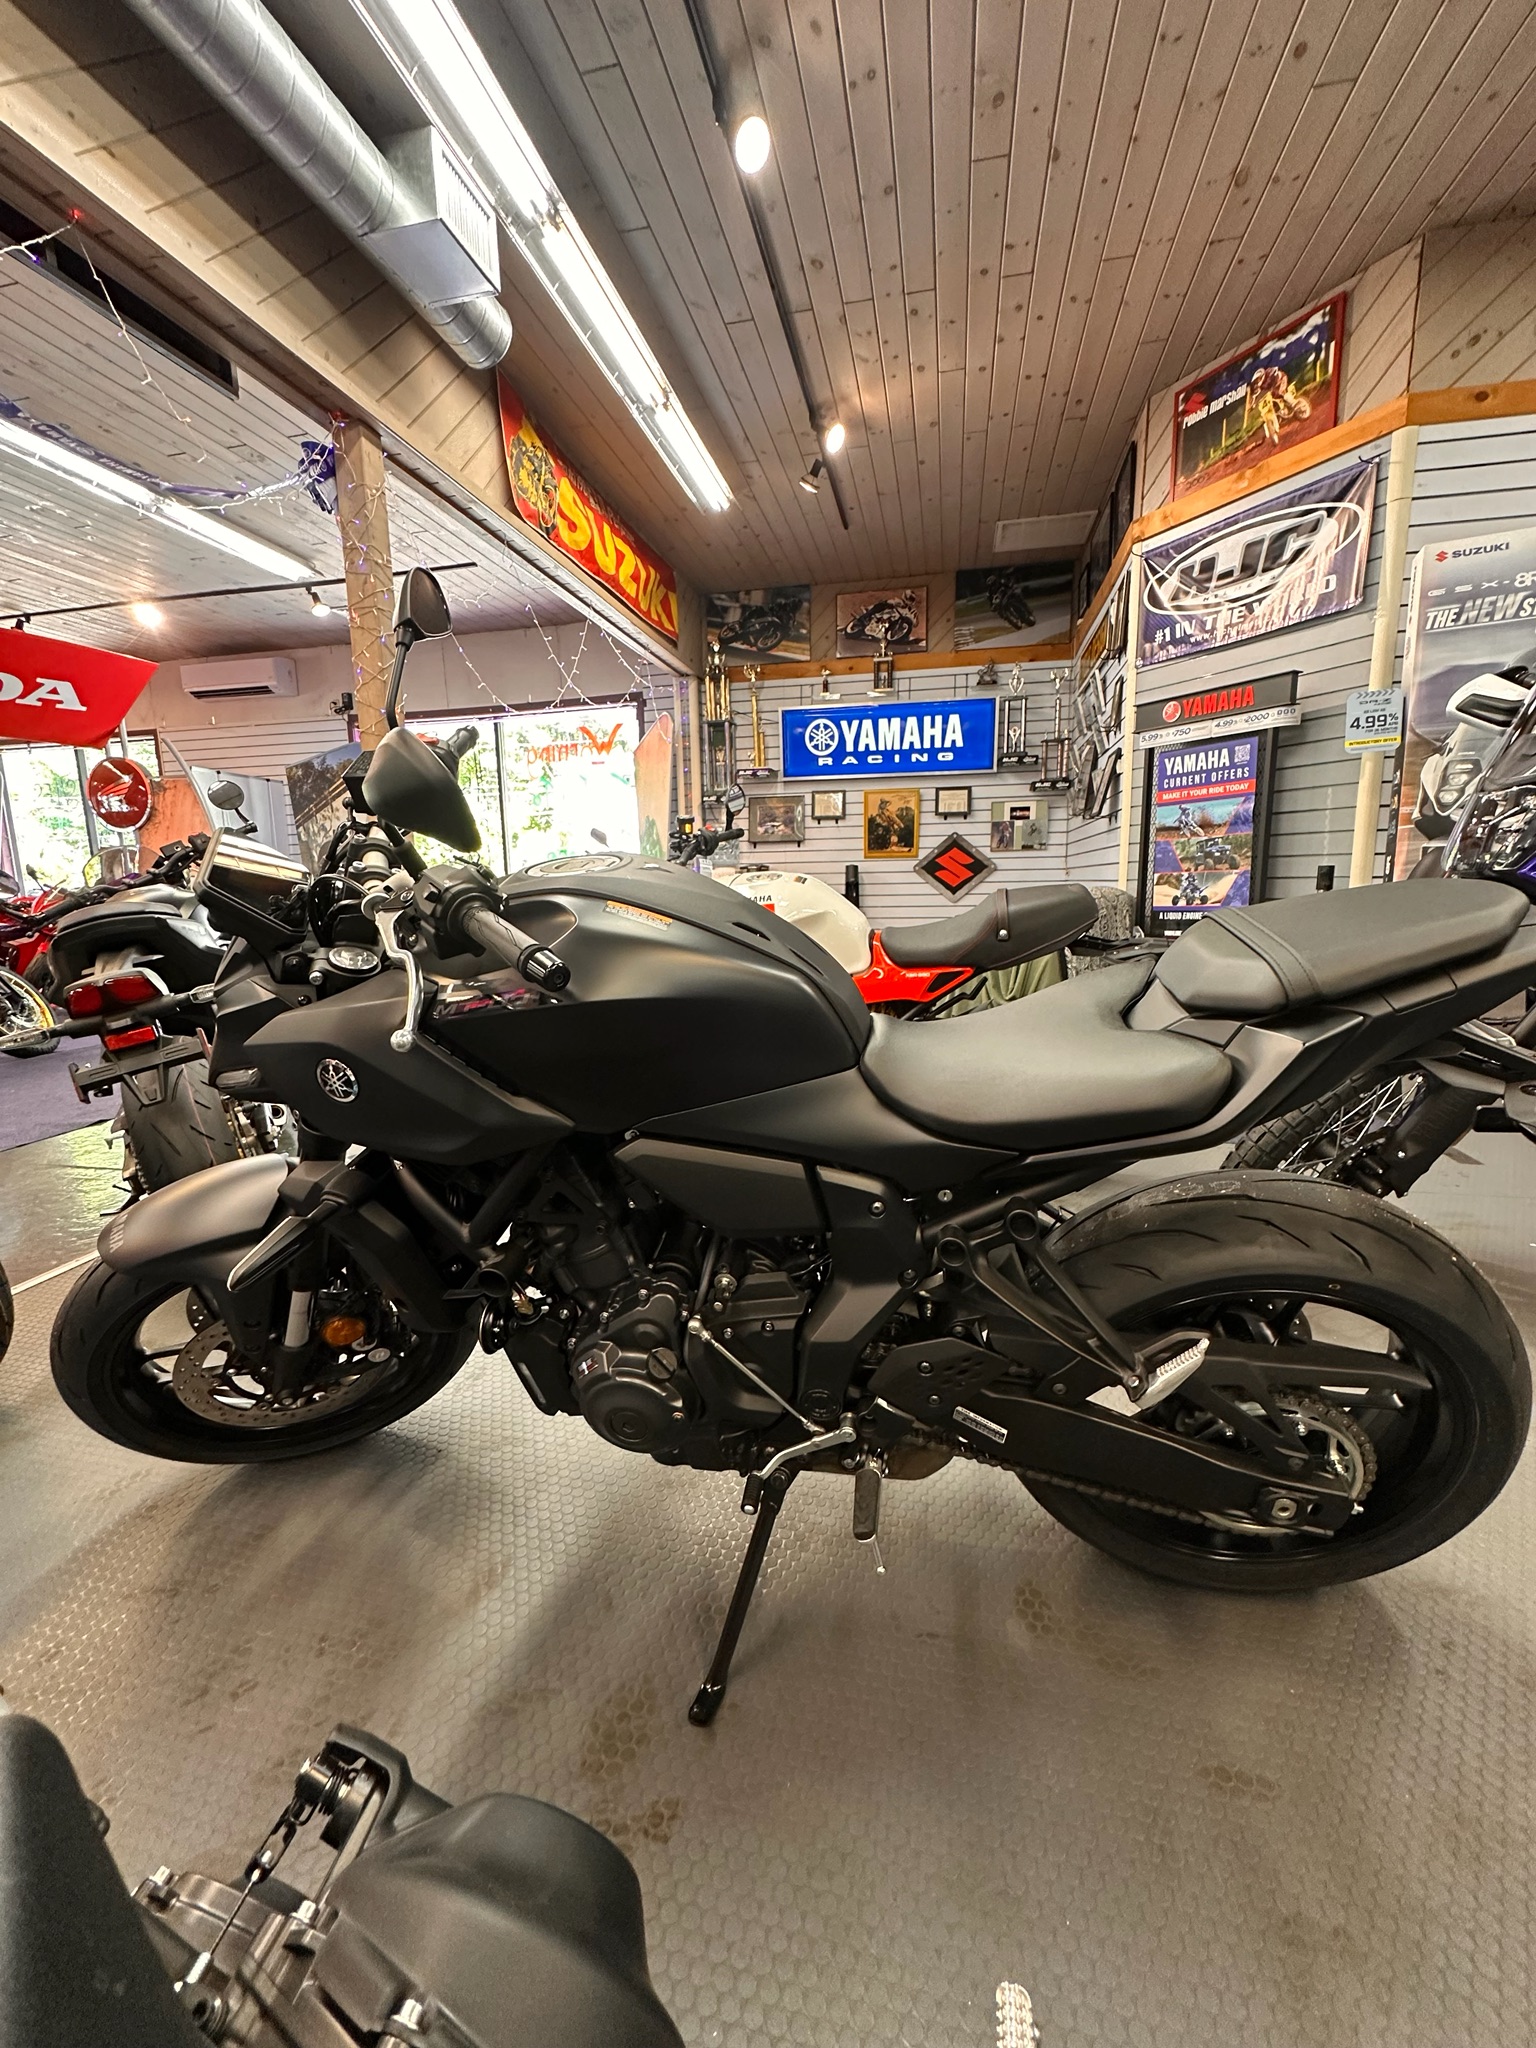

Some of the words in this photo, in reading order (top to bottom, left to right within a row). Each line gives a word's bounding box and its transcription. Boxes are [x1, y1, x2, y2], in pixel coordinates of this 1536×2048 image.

[557, 476, 679, 633] SUZUKI
[1170, 511, 1328, 603] HJC
[1451, 542, 1510, 559] SUZUKI
[1154, 626, 1173, 645] #1
[1175, 620, 1197, 639] IN
[1203, 605, 1246, 629] THE
[1425, 608, 1460, 630] THE
[1457, 591, 1533, 625] NEW
[1519, 597, 1536, 618] S
[1182, 685, 1255, 719] YAMAHA
[840, 714, 964, 752] YAMAHA
[1350, 712, 1399, 730] 4.99%
[818, 752, 955, 766] RACING
[1164, 748, 1230, 776] YAMAHA
[1162, 791, 1181, 800] MAKE
[1182, 790, 1188, 798] IT
[1189, 788, 1208, 796] YOUR
[1209, 785, 1225, 794] RIDE
[1226, 783, 1249, 792] TODAY
[1163, 773, 1207, 789] CURRENT
[1211, 767, 1250, 782] OFFERS
